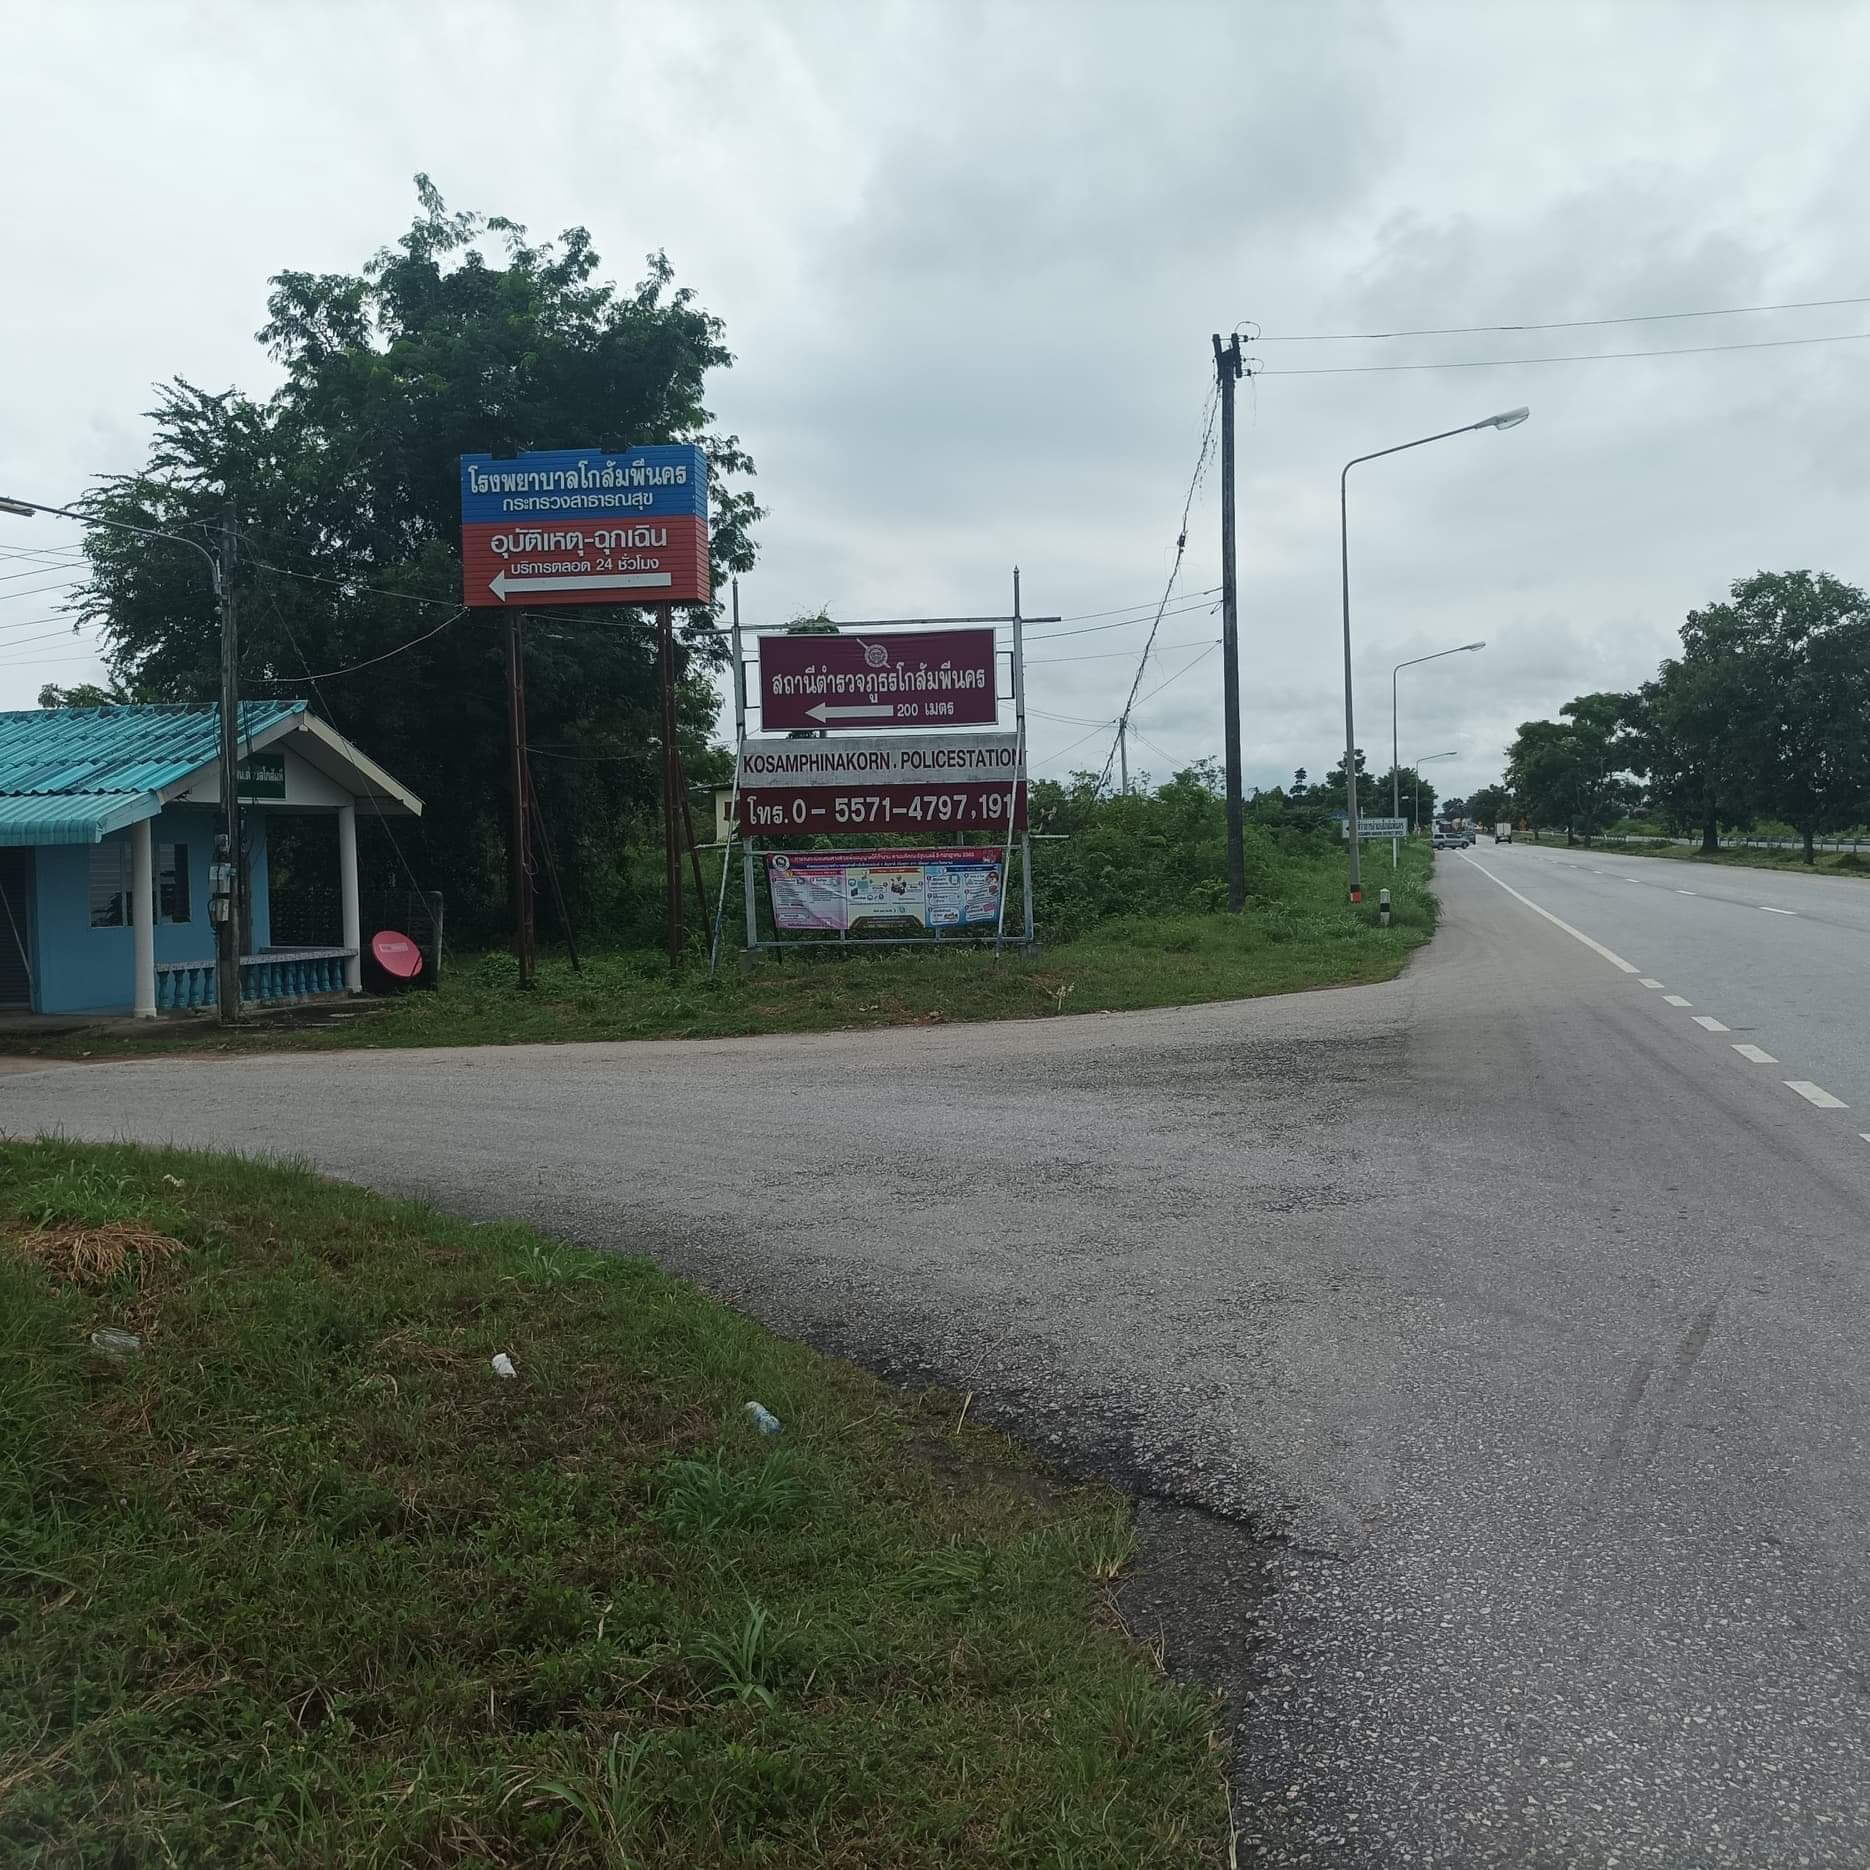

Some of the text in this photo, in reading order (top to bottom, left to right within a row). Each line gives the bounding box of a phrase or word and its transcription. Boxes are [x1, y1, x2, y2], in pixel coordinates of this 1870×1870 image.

[468, 458, 687, 494] โรงพยาบาลโกสัมพีนคร
[503, 491, 654, 512] กระทรวงสาธารณสุข
[490, 524, 668, 560] อุบัติเหตุ-ฉุกเฉิน
[511, 552, 660, 575] บริการตลอด 24 ชั่วโมง
[771, 660, 986, 704] สถานีตำรวจภูธรโกสัมพีนคร
[897, 701, 954, 718] 200 เมตร
